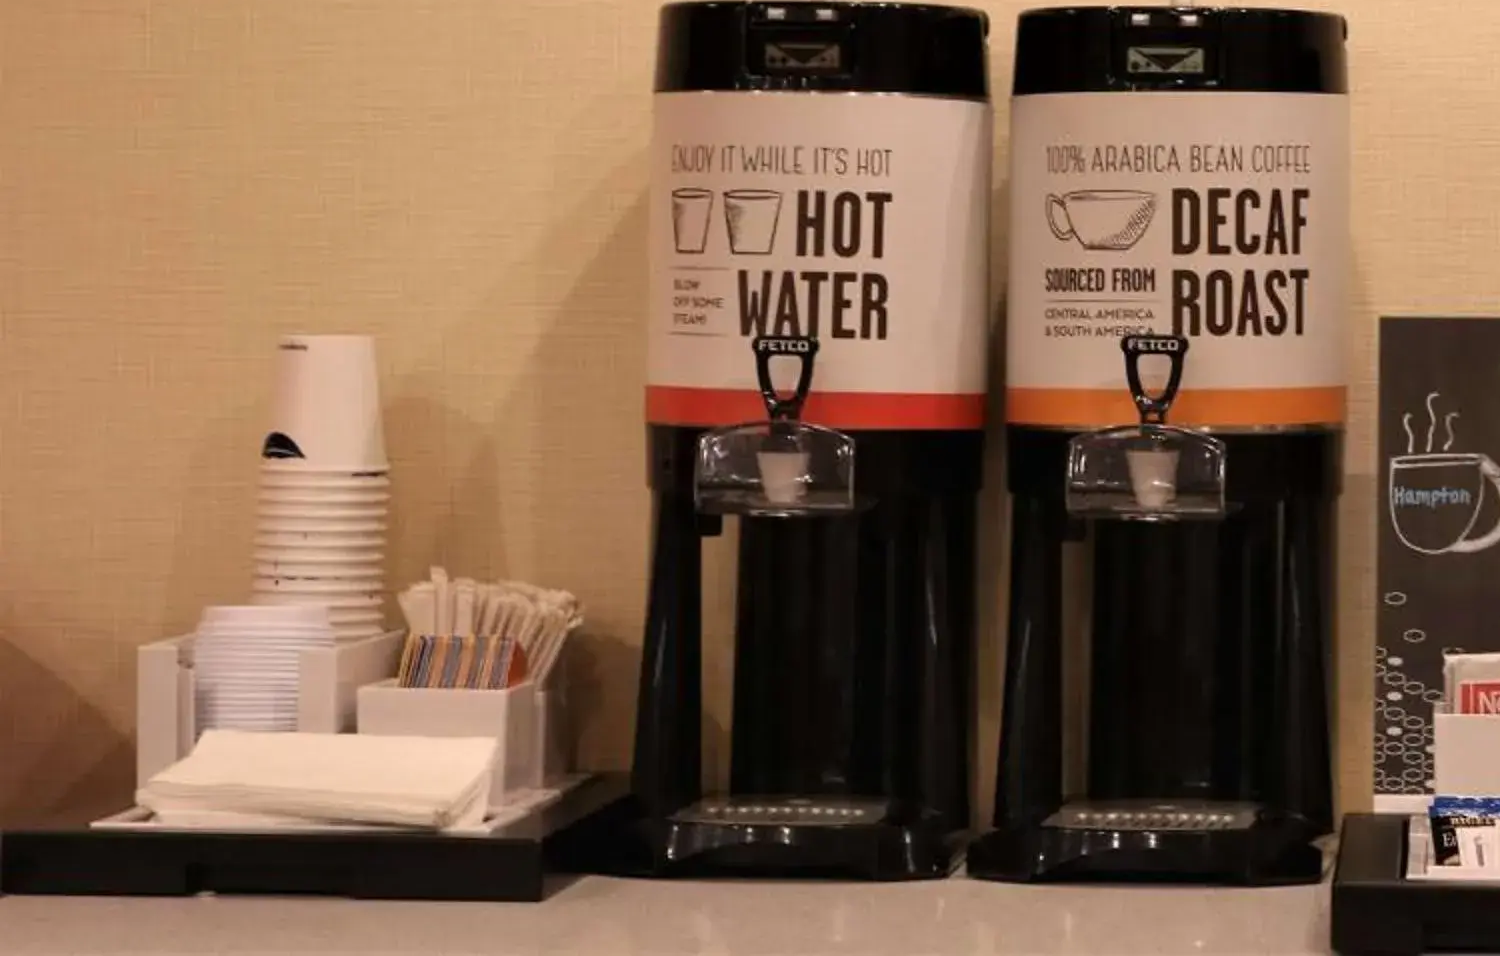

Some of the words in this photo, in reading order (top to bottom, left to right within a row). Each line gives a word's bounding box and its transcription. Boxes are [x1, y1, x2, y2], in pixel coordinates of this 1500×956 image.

[671, 144, 715, 174] ENJOY
[719, 145, 737, 173] IT
[740, 145, 806, 175] WHILE
[813, 147, 849, 176] IT'S
[856, 148, 893, 177] HOT
[1046, 145, 1086, 174] 100%
[1090, 145, 1181, 173] ARABICA
[1190, 145, 1244, 173] BEAN
[1251, 145, 1311, 174] COFFEE
[796, 190, 893, 259] HOT
[1171, 188, 1311, 255] DECAF
[1045, 268, 1105, 292] SOURCED
[1111, 268, 1156, 292] FROM
[738, 269, 889, 340] WATER
[1045, 308, 1092, 321] CENTRAL
[1096, 308, 1155, 320] AMERICA
[1171, 269, 1310, 336] ROAST
[1053, 325, 1092, 337] SOUTH
[1095, 326, 1155, 338] AMERICA
[758, 340, 810, 352] FETCO
[1127, 339, 1180, 352] FETCO
[1393, 486, 1471, 510] Hampton
